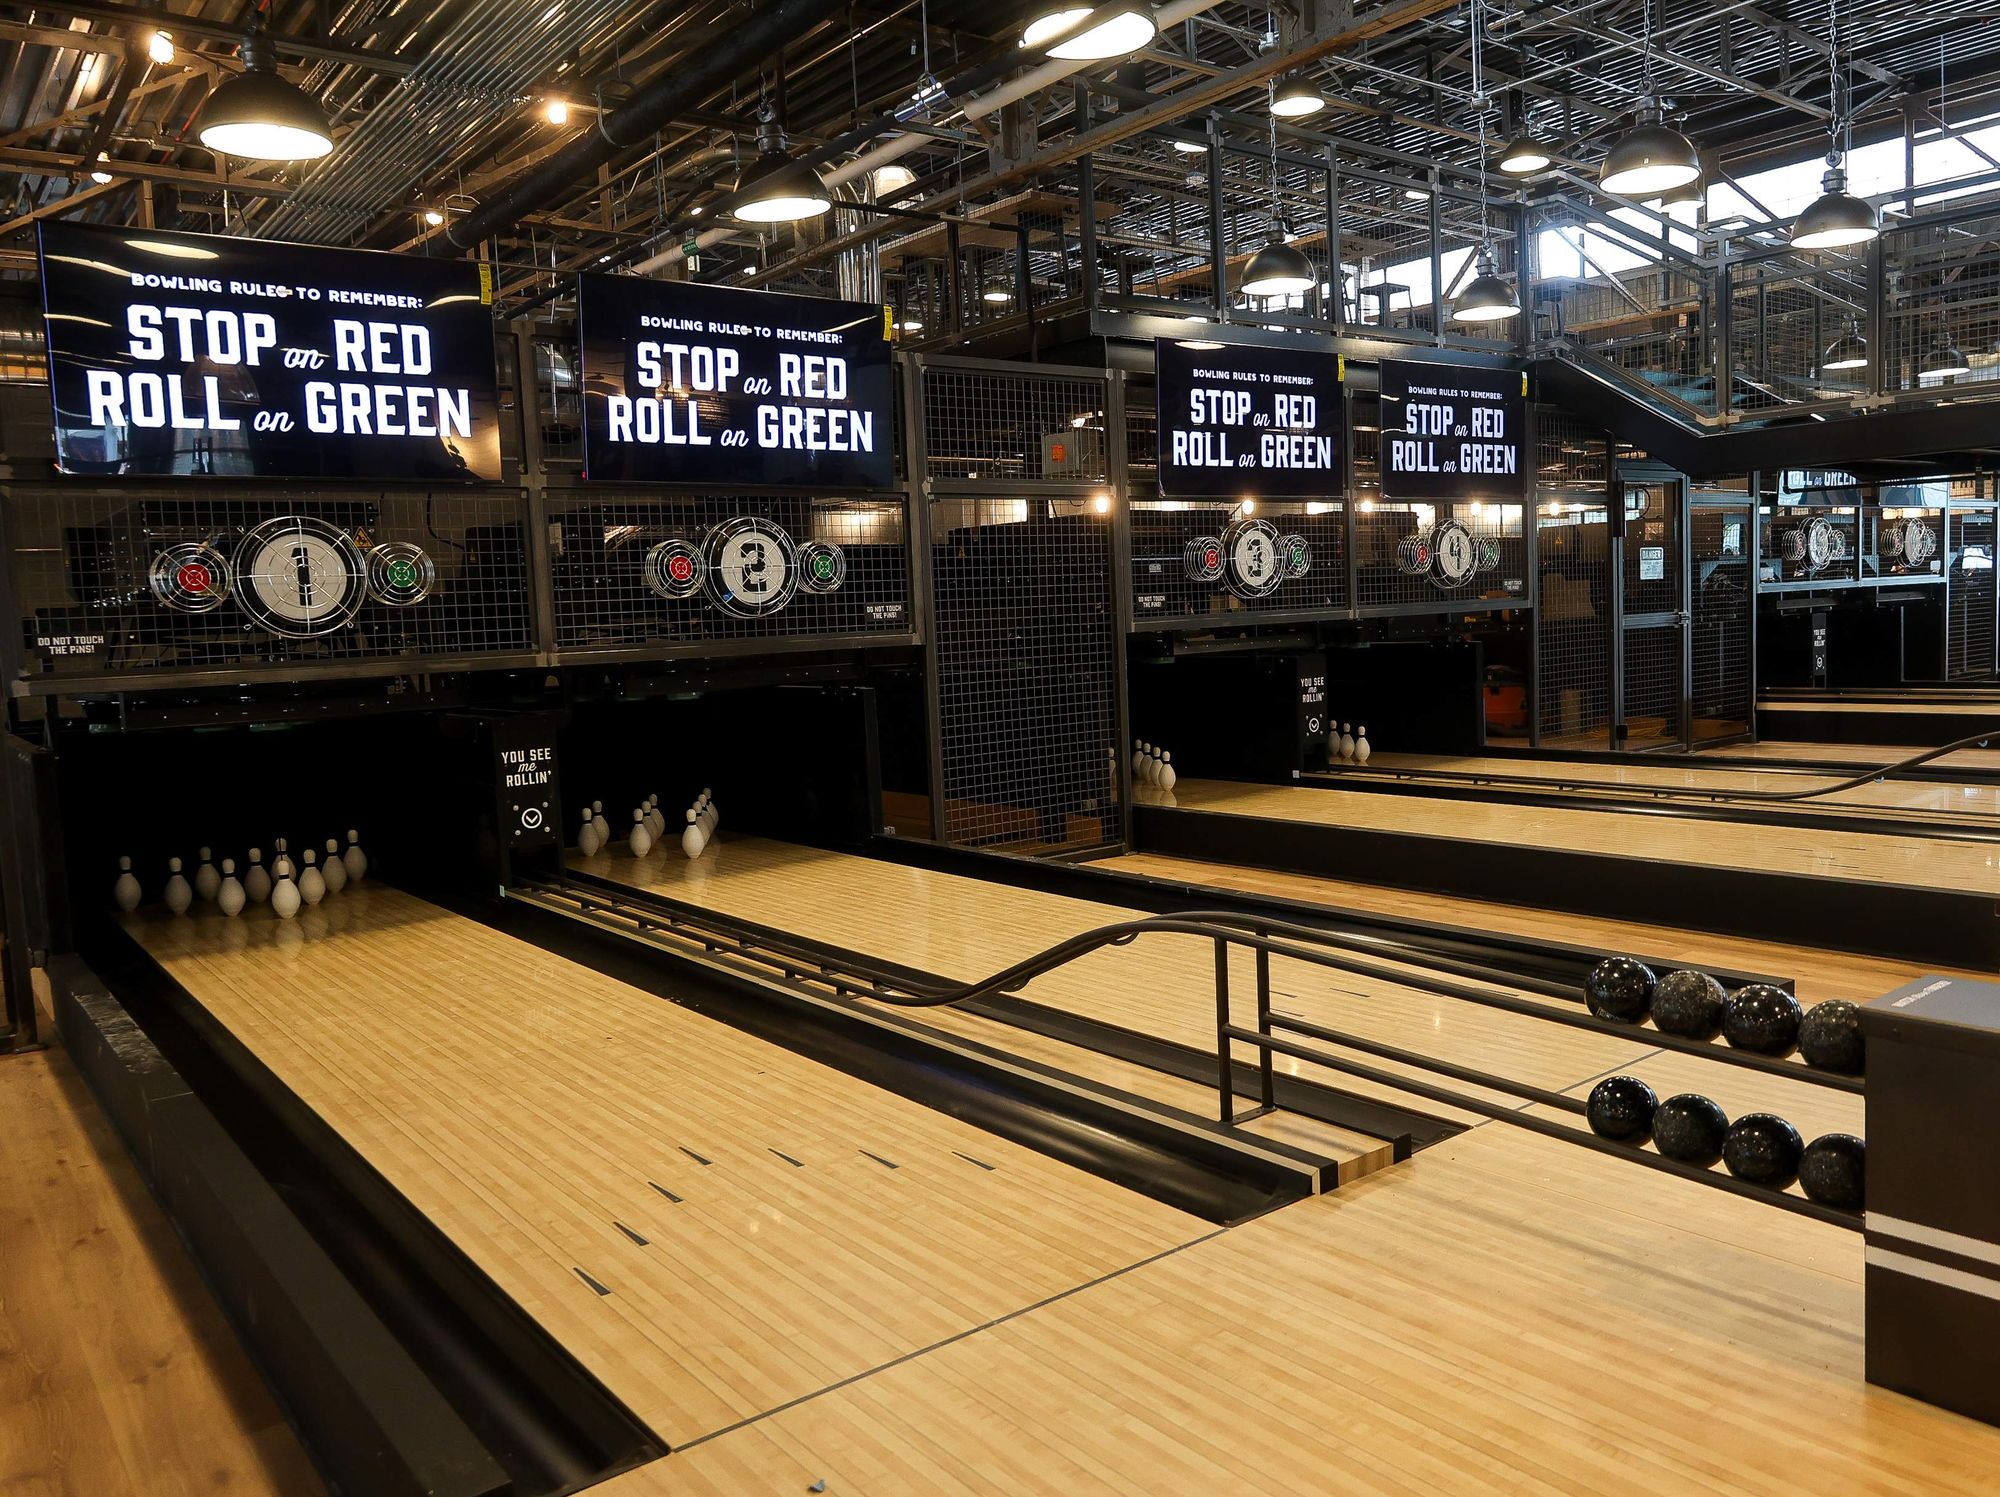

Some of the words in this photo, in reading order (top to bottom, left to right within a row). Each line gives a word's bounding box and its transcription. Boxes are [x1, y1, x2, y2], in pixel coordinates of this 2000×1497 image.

[131, 273, 222, 293] BOWLING
[296, 287, 320, 300] TO
[329, 290, 423, 309] REMEMBER:
[126, 304, 277, 366] STOP
[284, 346, 325, 371] on
[333, 319, 432, 376] RED
[641, 315, 703, 332] BOWLING
[754, 326, 772, 338] TO
[777, 328, 843, 345] REMEMBER:
[636, 341, 740, 393] STOP
[743, 376, 771, 396] on
[779, 353, 847, 400] RED
[1192, 368, 1230, 380] BOWLING
[1232, 371, 1257, 382] RULES
[1259, 374, 1271, 383] TO
[1273, 375, 1314, 386] REMEMBER:
[86, 370, 240, 431] ROLL
[253, 407, 295, 433] on
[304, 381, 472, 438] GREEN
[1190, 388, 1252, 426] STOP
[1253, 412, 1271, 427] on
[1274, 393, 1316, 429] RED
[1408, 386, 1437, 396] BOWLING
[1439, 388, 1458, 397] RULES
[1460, 390, 1469, 398] TO
[1471, 390, 1503, 400] REMEMBER:
[607, 395, 711, 446] ROLL
[720, 428, 749, 448] on
[757, 404, 874, 452] GREEN
[1406, 403, 1454, 436] STOP
[1454, 424, 1469, 437] on
[1471, 407, 1504, 438] RED
[1172, 430, 1234, 467] ROLL
[1238, 453, 1257, 468] on
[1261, 433, 1332, 469] GREEN
[1392, 440, 1440, 472] ROLL
[1443, 460, 1457, 473] on
[1460, 443, 1516, 474] GREEN
[740, 543, 767, 592] 2
[1247, 539, 1263, 577] 3
[1450, 535, 1461, 570] 4
[291, 547, 313, 606] 1
[885, 604, 902, 612] TOUCH
[37, 637, 51, 647] DO
[52, 636, 72, 646] NOT
[73, 635, 105, 645] TOUCH
[48, 646, 68, 655] THE
[1300, 678, 1312, 687] YOU
[1313, 676, 1325, 686] SEE
[501, 750, 525, 764] YOU
[529, 748, 552, 761] SEE
[517, 762, 538, 773] me
